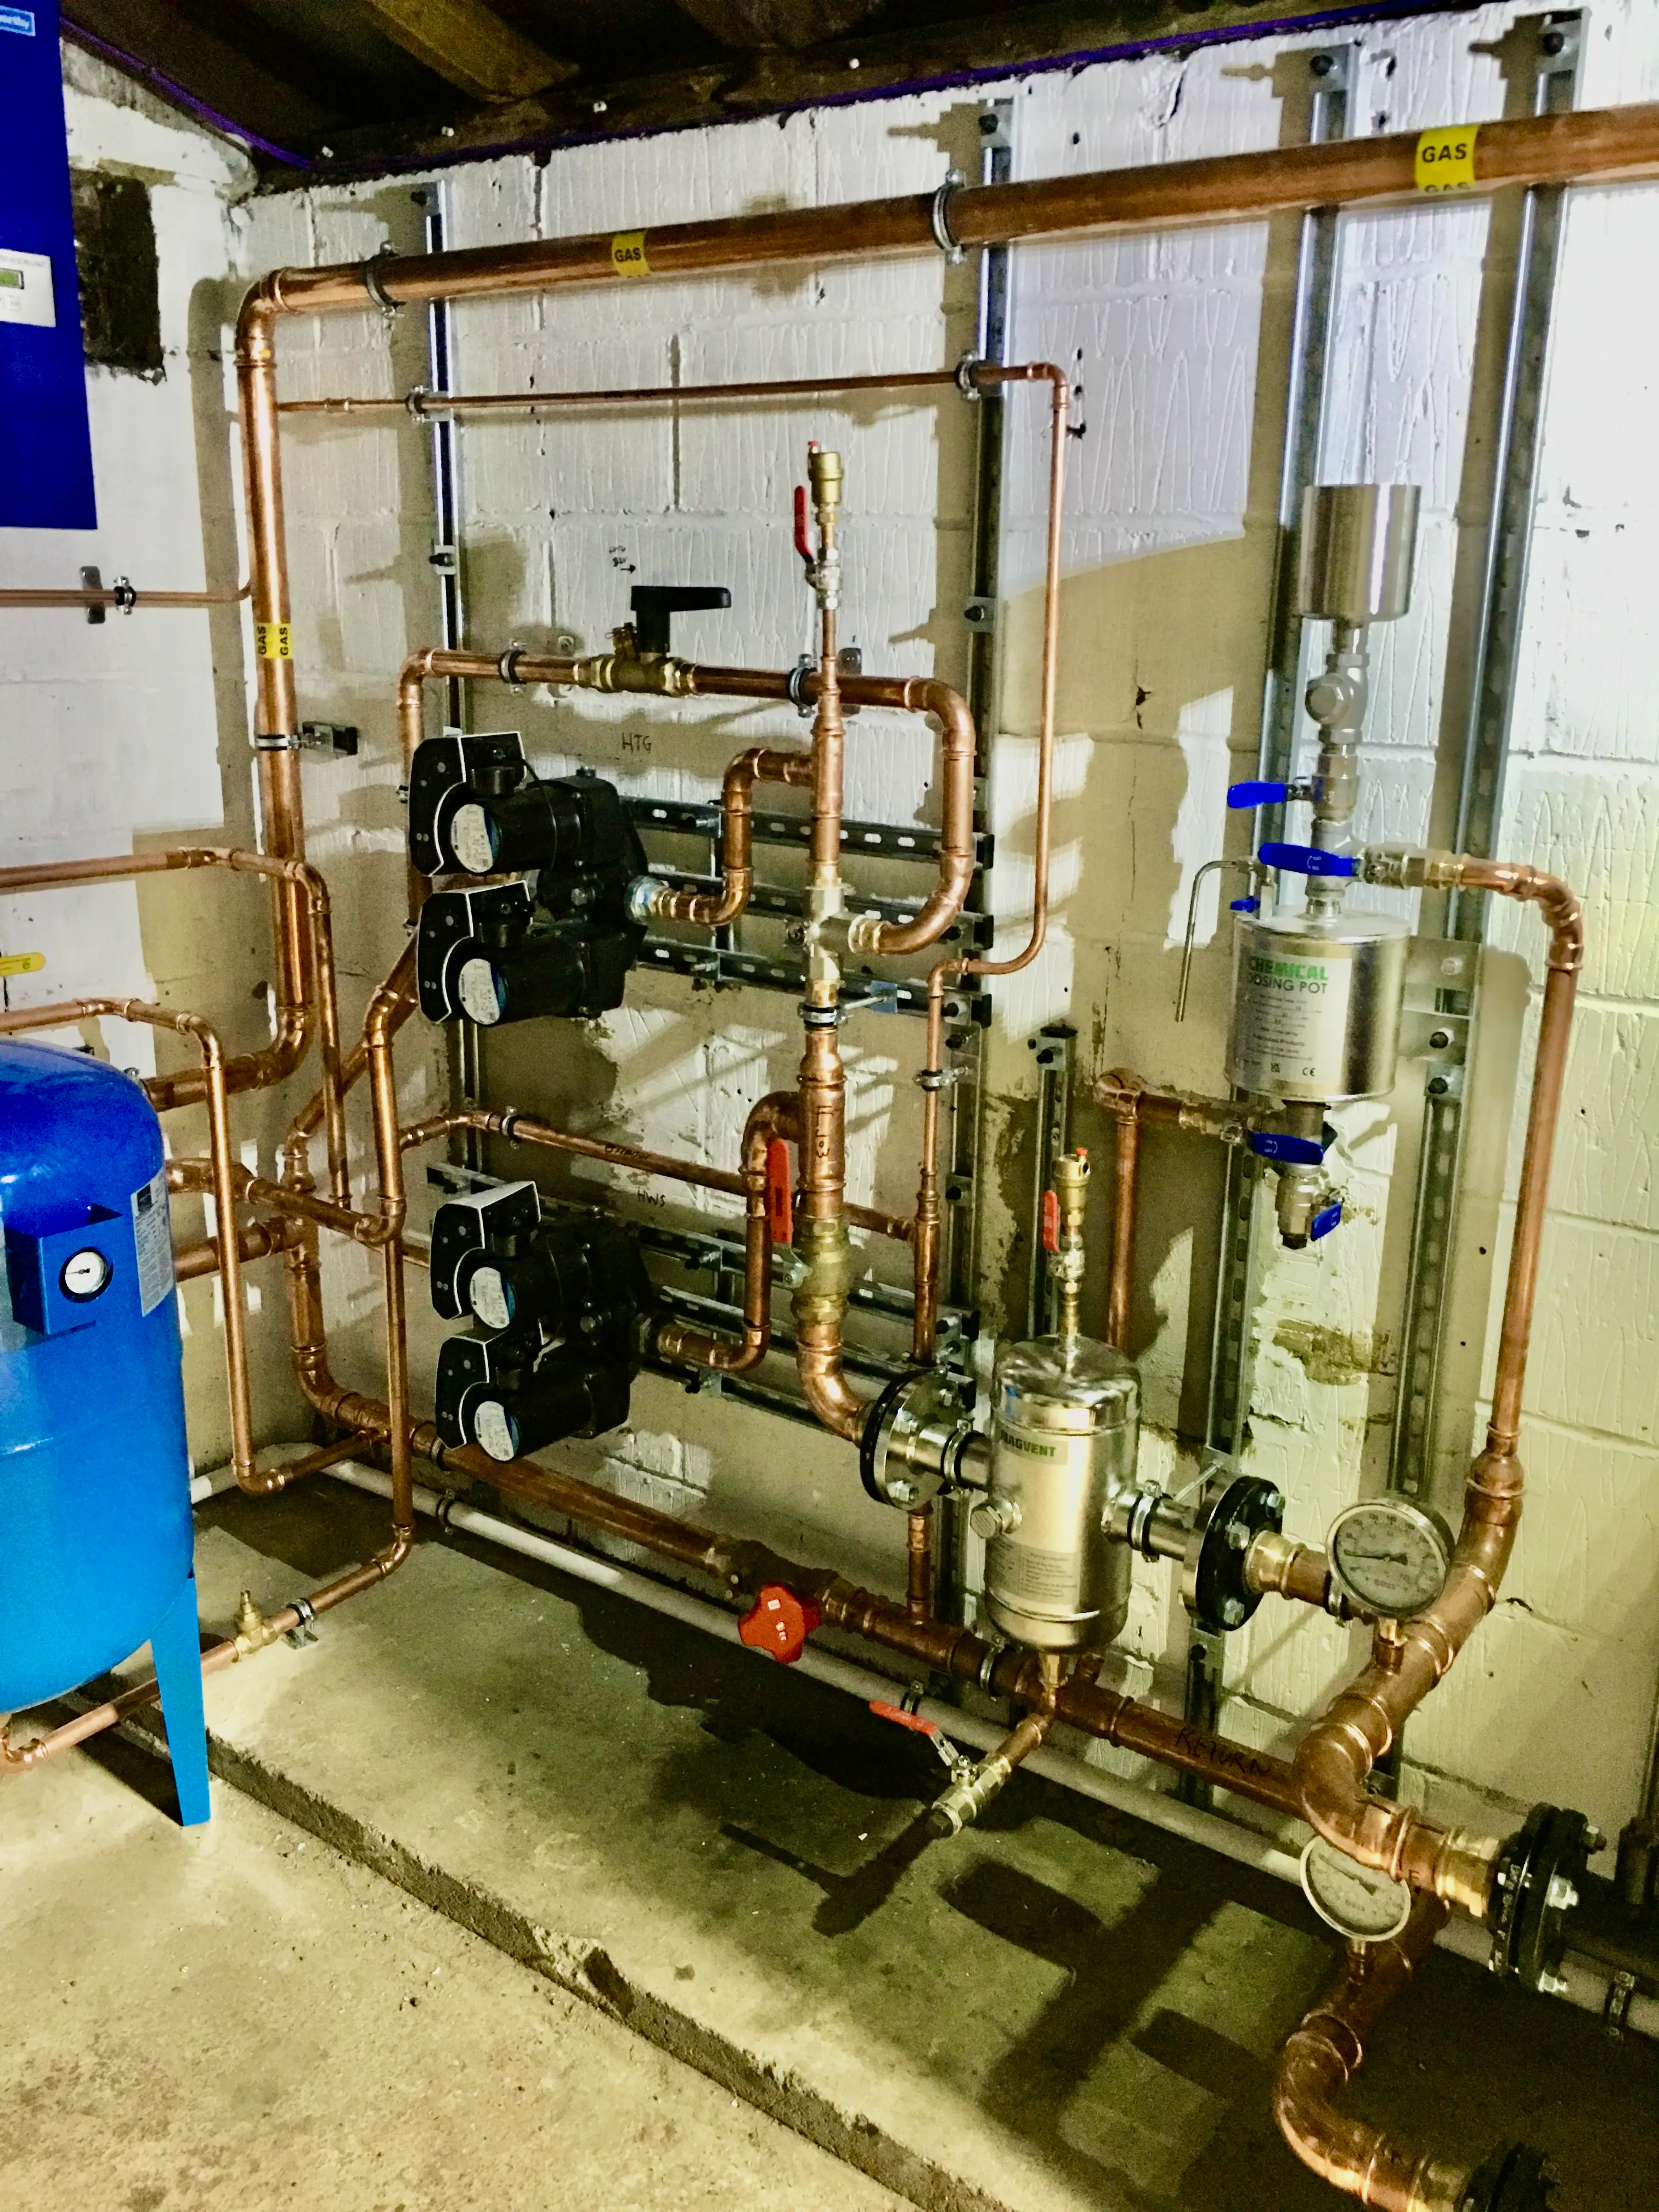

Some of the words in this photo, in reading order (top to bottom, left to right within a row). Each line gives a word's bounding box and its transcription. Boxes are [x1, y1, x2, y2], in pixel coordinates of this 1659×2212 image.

[1422, 143, 1467, 163] GAS
[614, 247, 641, 262] GAS
[257, 626, 267, 654] GAS
[279, 627, 289, 656] GAS
[622, 732, 652, 754] HTG
[1249, 956, 1329, 980] CHEMICAL
[1248, 973, 1294, 991] DOSING
[1299, 981, 1328, 994] POT
[637, 1187, 665, 1207] HWS
[1000, 1429, 1057, 1457] MAGVENT
